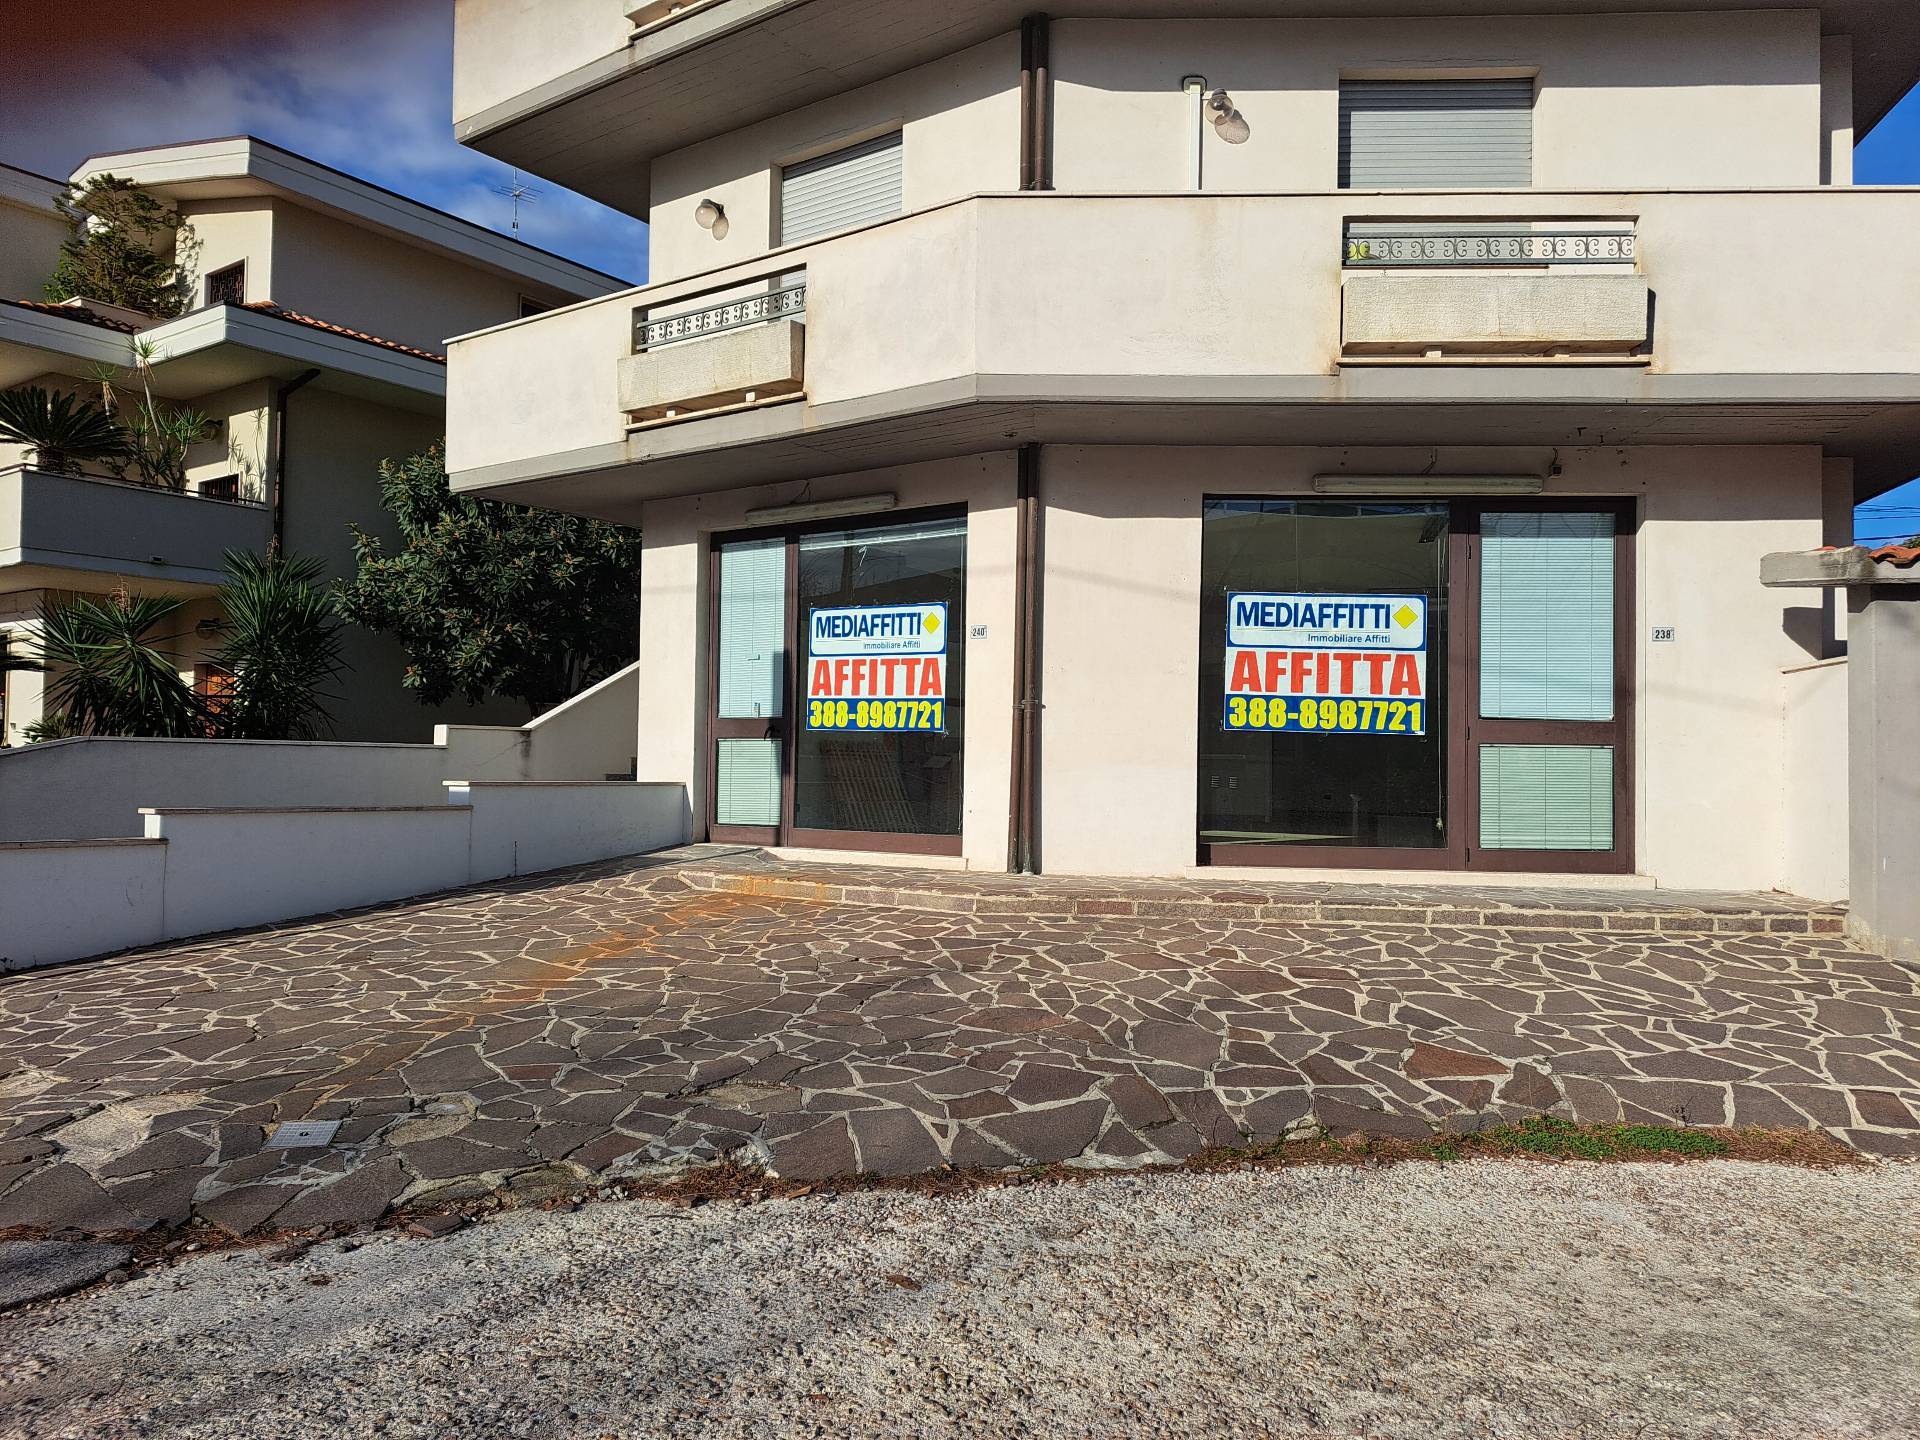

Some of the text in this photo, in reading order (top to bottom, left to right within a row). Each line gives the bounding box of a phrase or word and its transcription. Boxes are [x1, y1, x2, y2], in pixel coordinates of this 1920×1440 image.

[815, 612, 921, 638] MEDIAFFITTI
[1236, 601, 1391, 629] MEDIAFFITTI
[863, 640, 921, 650] Immobiliare Affitti
[972, 627, 985, 637] 240
[1307, 633, 1391, 643] Immobiliare Affitti
[1655, 629, 1671, 639] 238
[811, 657, 942, 696] AFFITTA
[1230, 651, 1421, 696] AFFITTA
[809, 700, 942, 728] 388-8987721
[1229, 697, 1421, 732] 388-8987721
